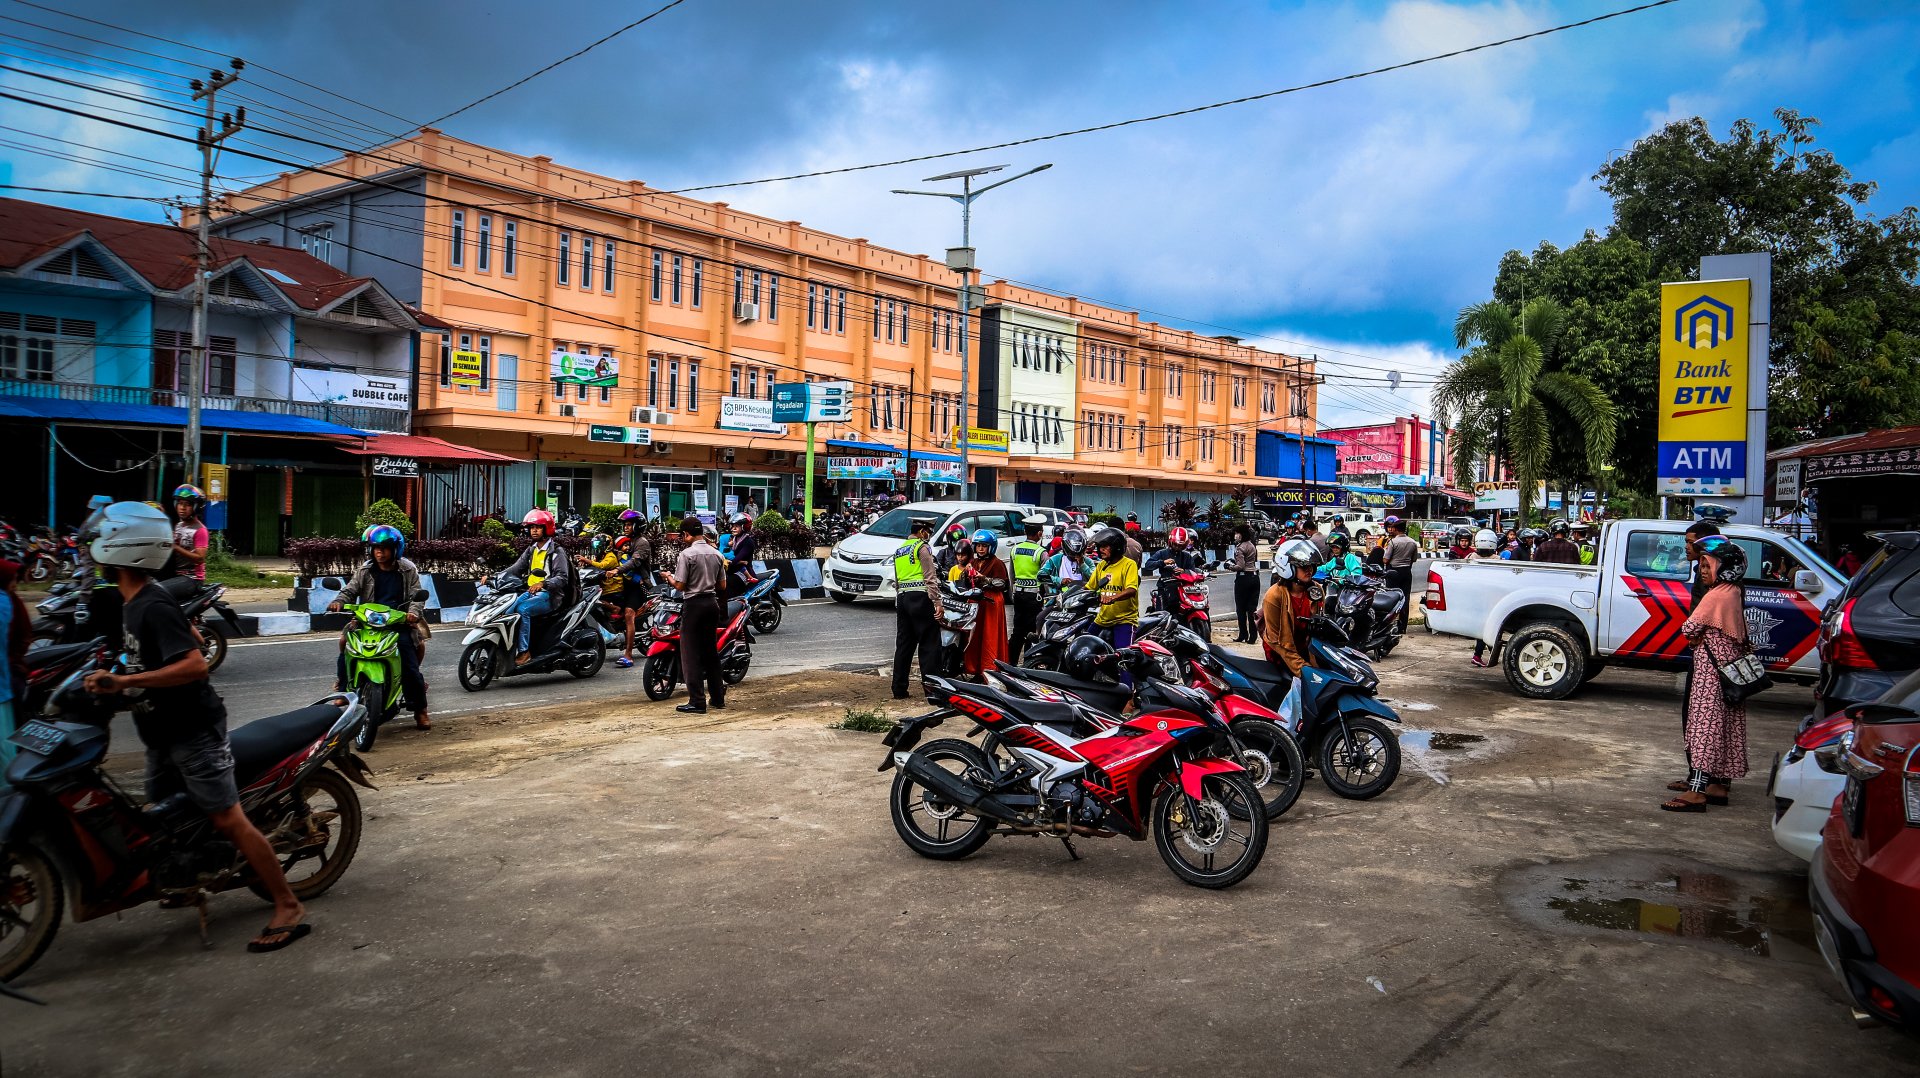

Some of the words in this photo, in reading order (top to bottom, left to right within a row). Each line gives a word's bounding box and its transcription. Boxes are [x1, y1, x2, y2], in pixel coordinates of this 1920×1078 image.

[1674, 359, 1733, 379] Bank
[352, 389, 385, 400] BUBBLE
[387, 392, 408, 402] CAFE
[1674, 386, 1732, 404] BTN
[734, 403, 748, 412] BPJS
[776, 401, 804, 410] Pegadaian
[380, 456, 418, 468] Bubble
[1672, 447, 1732, 470] ATM
[1780, 464, 1799, 473] HOTSPOT
[1779, 475, 1795, 484] SANTAI
[1778, 486, 1796, 496] BARENG
[1762, 591, 1797, 599] MELAYANI
[1765, 655, 1789, 663] LINTAS
[949, 695, 1003, 722] 150
